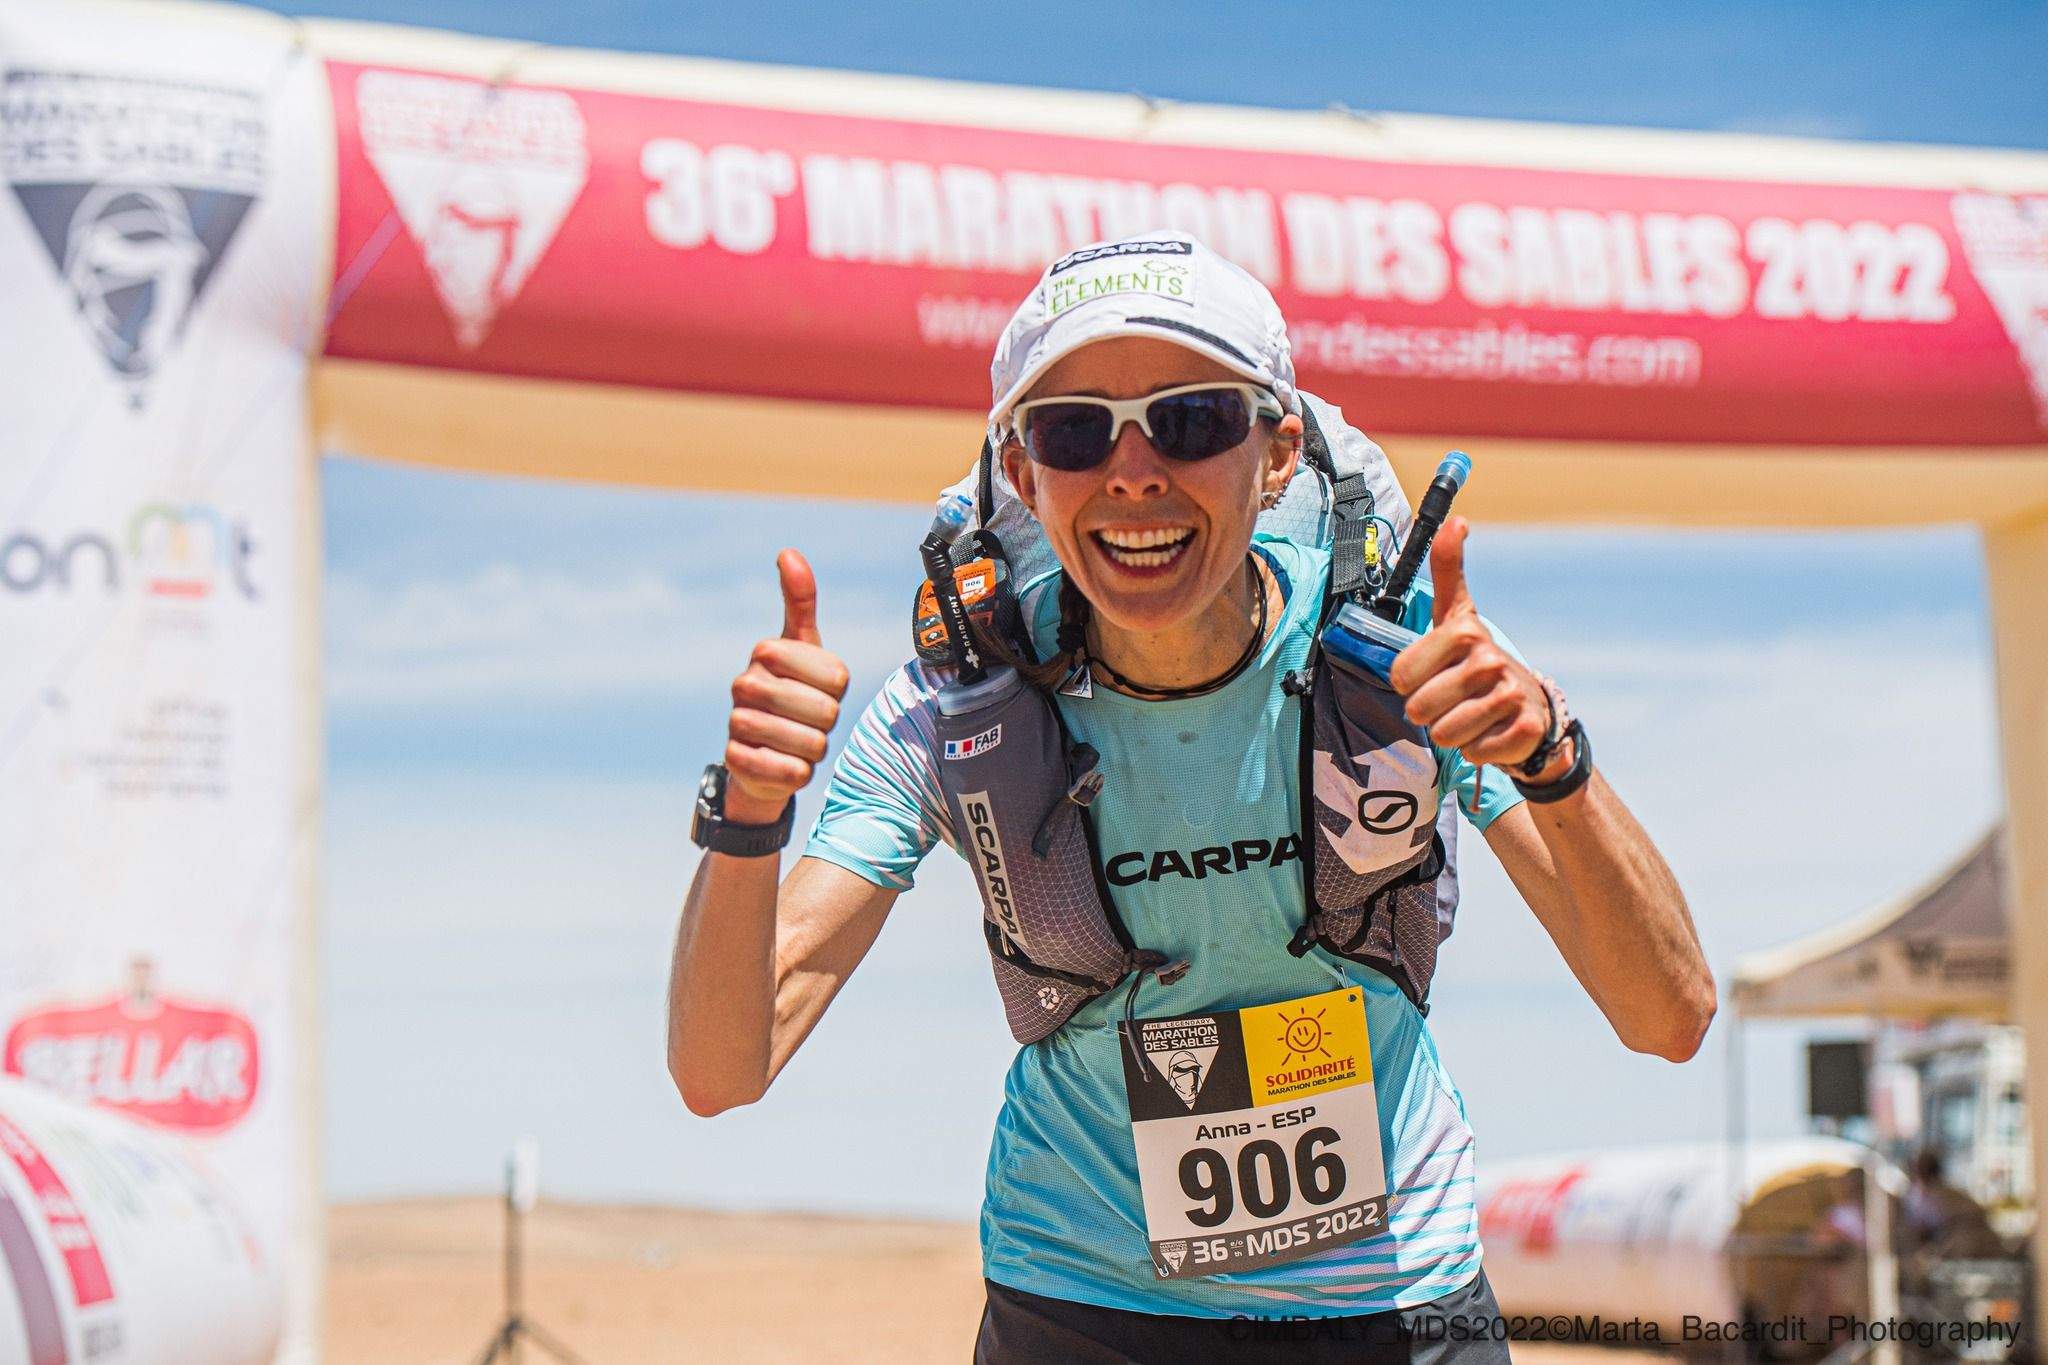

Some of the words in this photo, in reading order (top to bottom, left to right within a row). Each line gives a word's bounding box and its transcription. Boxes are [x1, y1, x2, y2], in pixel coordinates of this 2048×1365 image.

[803, 153, 1285, 290] MARATHON
[1284, 191, 1450, 304] DES
[1450, 202, 1749, 318] SABLES
[1745, 217, 1955, 323] 2022
[1052, 272, 1183, 314] ELEMENTS
[1054, 276, 1075, 291] THE
[974, 728, 999, 749] FAB
[966, 802, 1019, 934] SCARPA
[1105, 832, 1302, 887] CARPA
[1142, 1026, 1218, 1041] MARATHON
[1165, 1019, 1211, 1028] LEGENDARY
[1144, 1041, 1169, 1052] DES
[1171, 1035, 1219, 1049] SABLES
[1266, 1055, 1356, 1088] SOLIDARITÉ
[1268, 1082, 1311, 1096] MARATHON
[1312, 1077, 1327, 1086] DES
[1328, 1071, 1356, 1083] SABLES
[1195, 1123, 1251, 1141] Anna
[1272, 1106, 1316, 1129] ESP
[1178, 1126, 1347, 1228] 906
[1192, 1238, 1228, 1264] 36
[1246, 1223, 1310, 1257] MDS
[1316, 1203, 1379, 1233] 2022
[1234, 1250, 1243, 1258] th
